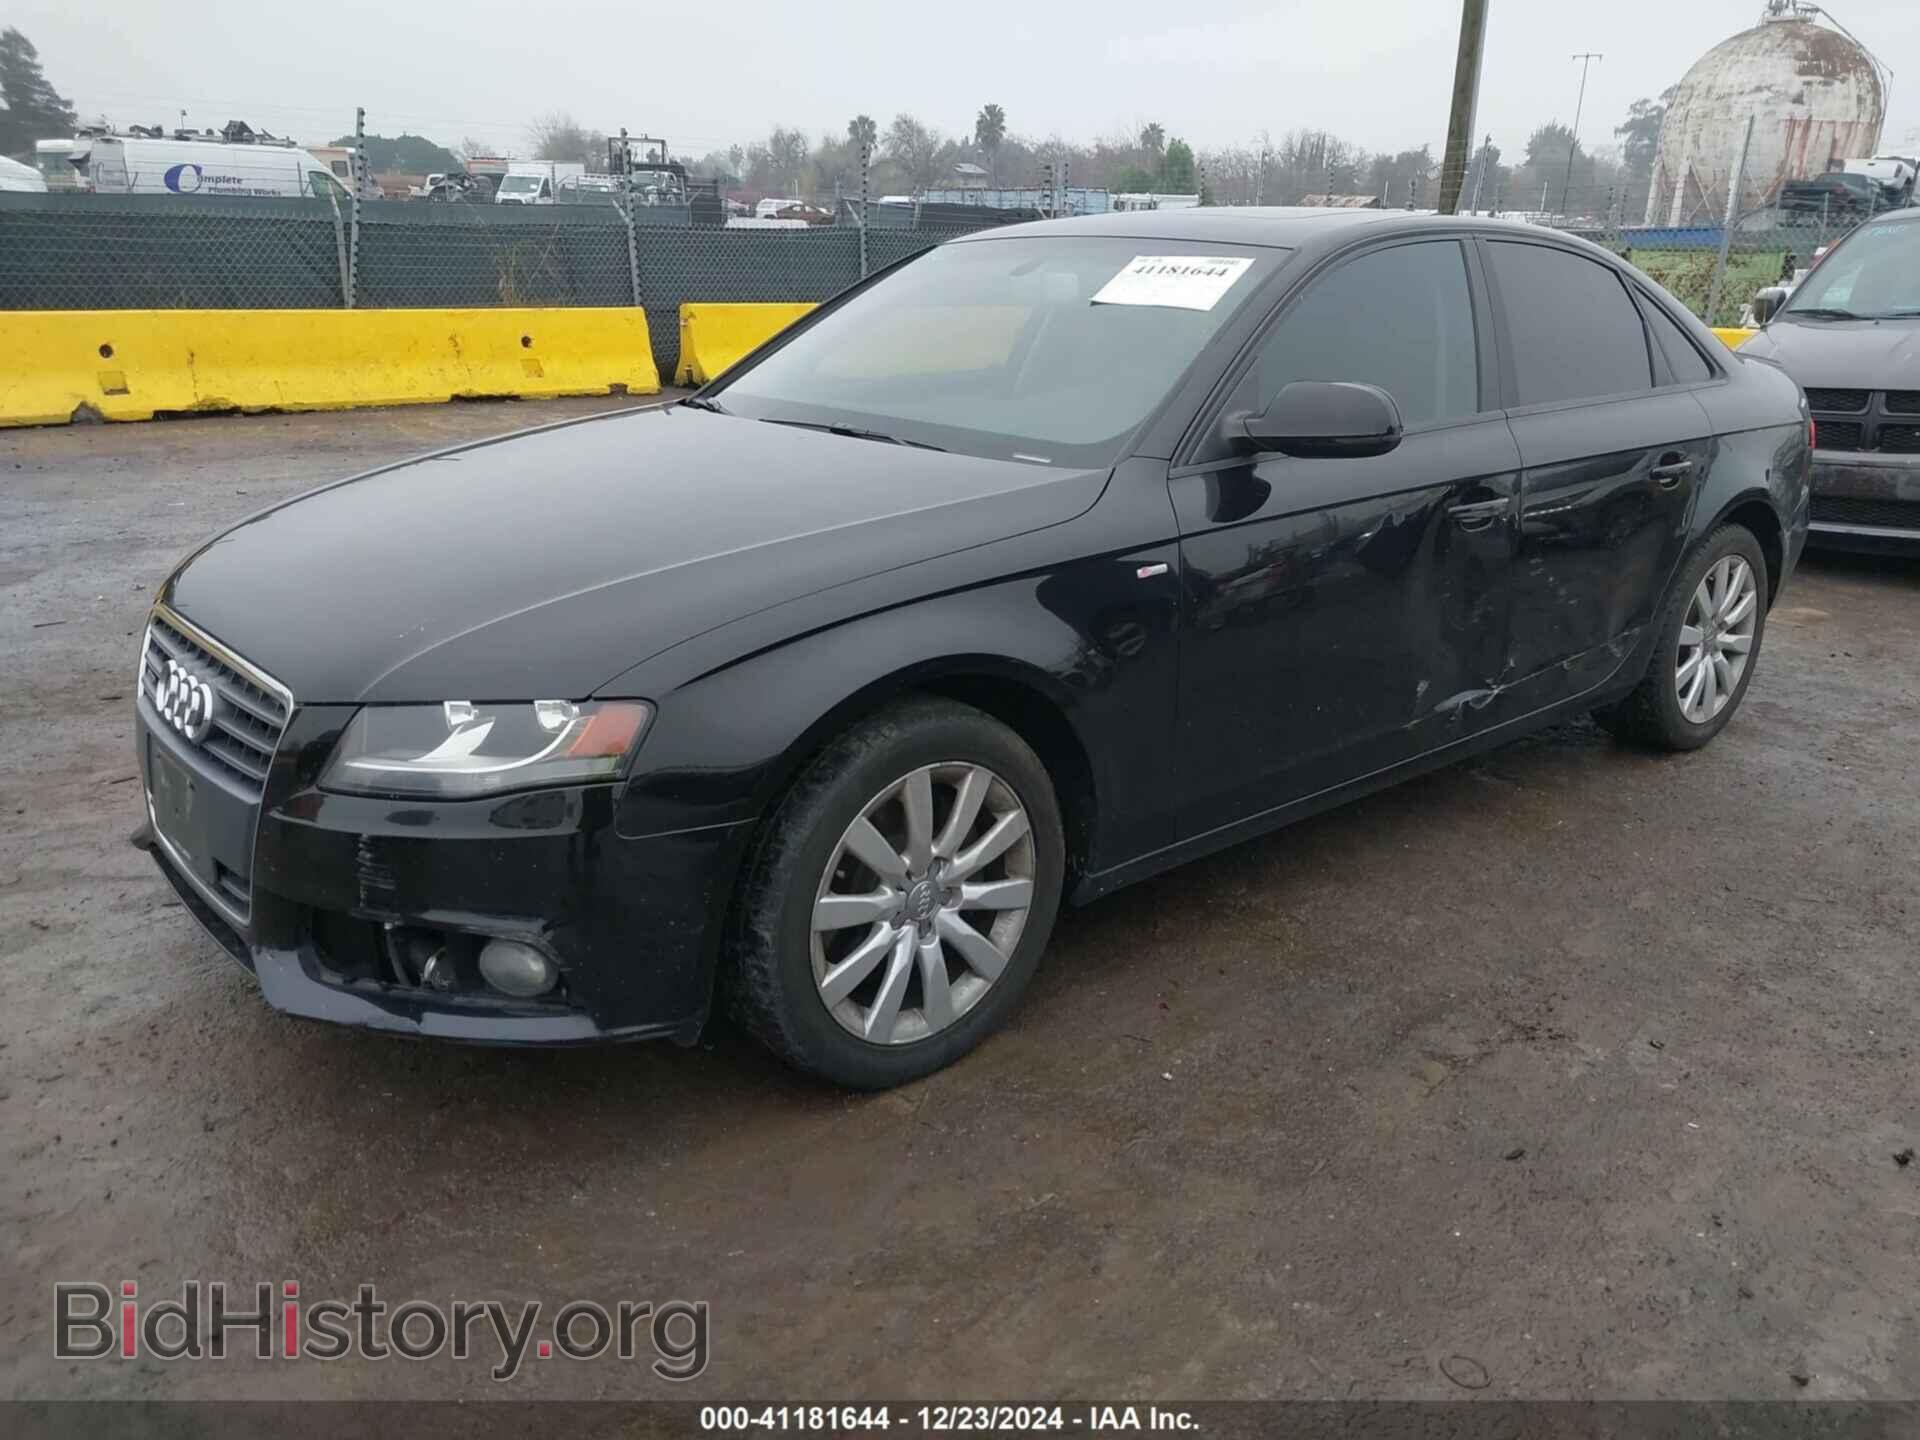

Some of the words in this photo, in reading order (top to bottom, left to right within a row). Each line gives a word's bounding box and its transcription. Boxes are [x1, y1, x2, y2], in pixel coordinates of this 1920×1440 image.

[164, 164, 242, 193] Complete
[253, 188, 282, 196] Works
[1134, 265, 1229, 277] 41181644
